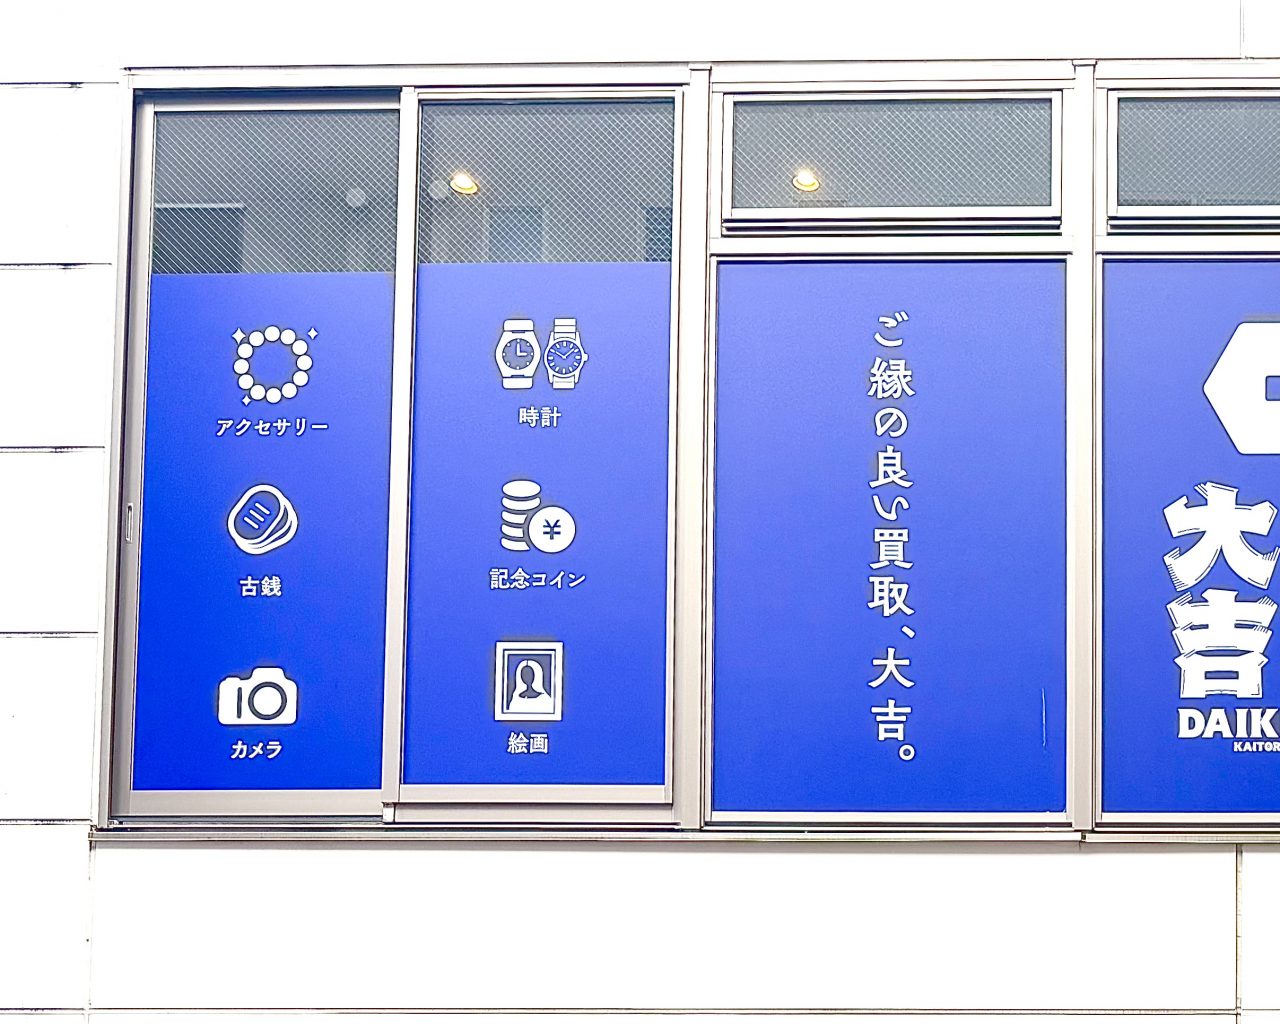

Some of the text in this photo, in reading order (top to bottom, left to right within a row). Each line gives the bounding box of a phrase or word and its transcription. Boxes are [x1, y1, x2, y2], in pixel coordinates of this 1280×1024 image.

[216, 418, 329, 436] アクセサリー
[518, 407, 561, 427] 時計
[868, 311, 915, 761] ご縁の良い買取、大吉。
[239, 576, 281, 596] 古銭
[489, 568, 586, 590] 記念コイン
[231, 740, 282, 759] カメラ
[507, 733, 549, 754] 絵画
